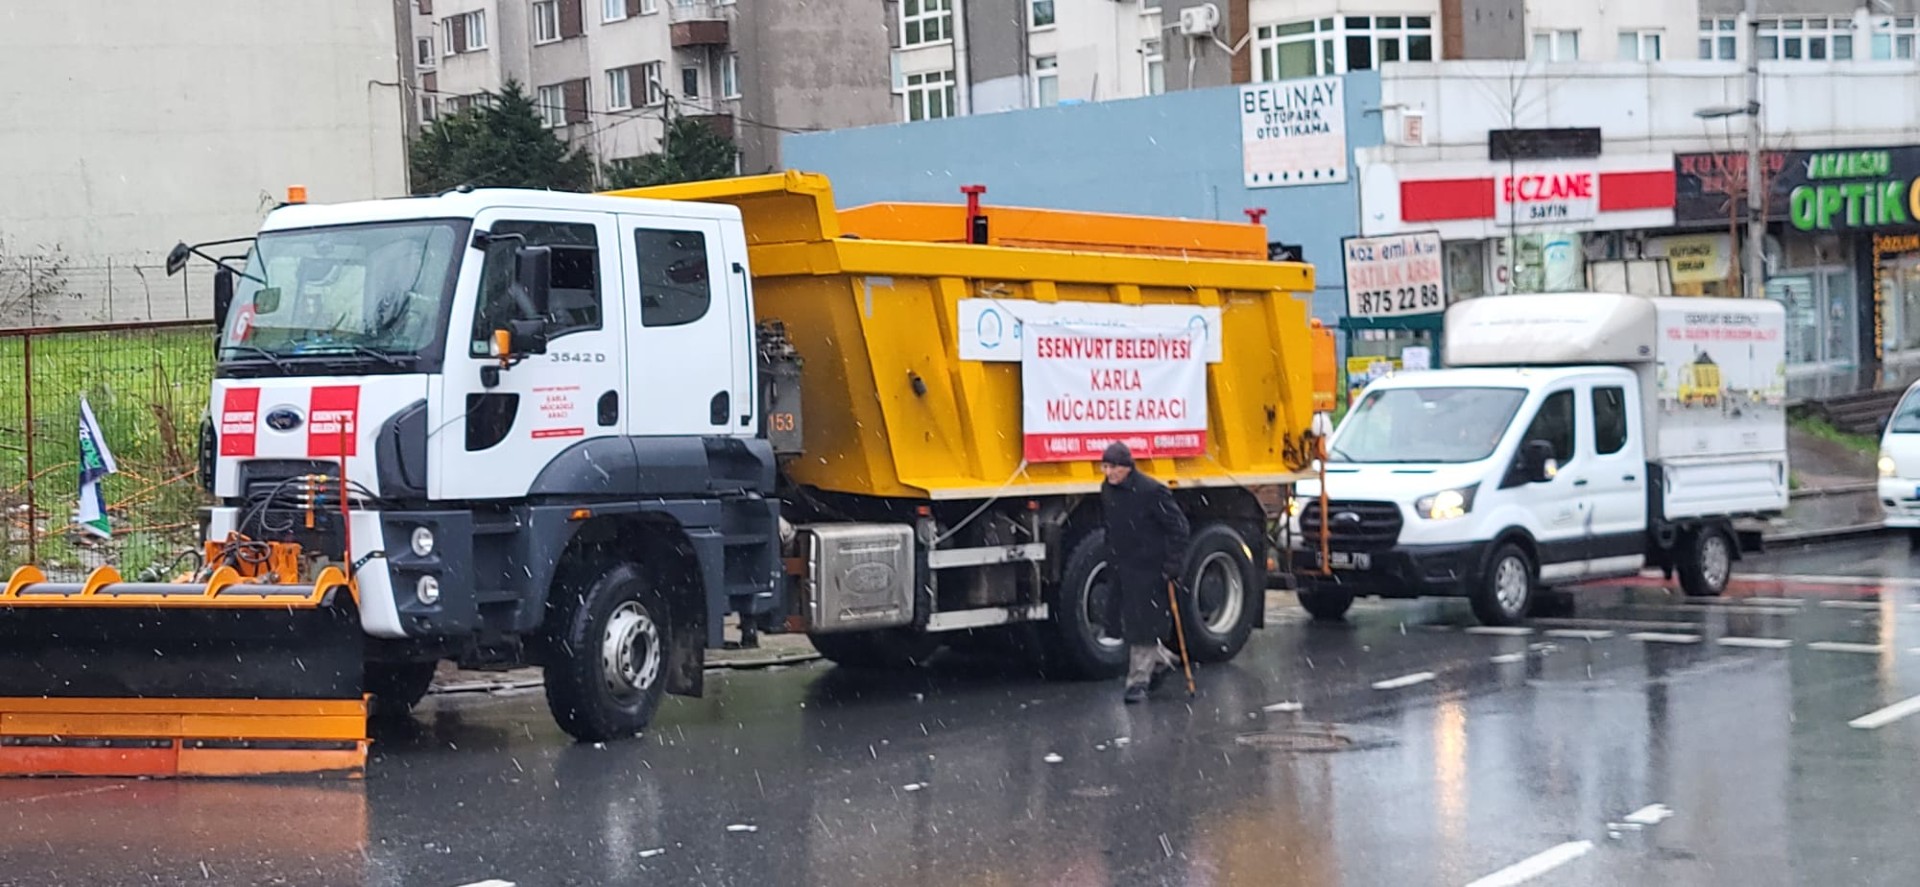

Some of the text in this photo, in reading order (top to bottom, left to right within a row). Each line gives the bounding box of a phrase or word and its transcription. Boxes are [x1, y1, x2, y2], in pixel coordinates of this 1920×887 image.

[1265, 109, 1320, 124] OTOPARK
[1257, 122, 1330, 139] OTO YIKAMA
[1504, 174, 1593, 202] ECZANE
[1530, 204, 1567, 218] SAYIN
[1790, 180, 1906, 231] OPTİK
[1362, 289, 1392, 313] 875
[1397, 287, 1417, 310] 22
[1421, 284, 1438, 307] 88
[1038, 333, 1191, 359] ESENYURT BELEDİYESİ
[1091, 369, 1142, 390] KARLA
[1047, 394, 1186, 421] MÜCADELE ARACI
[769, 413, 794, 431] 153
